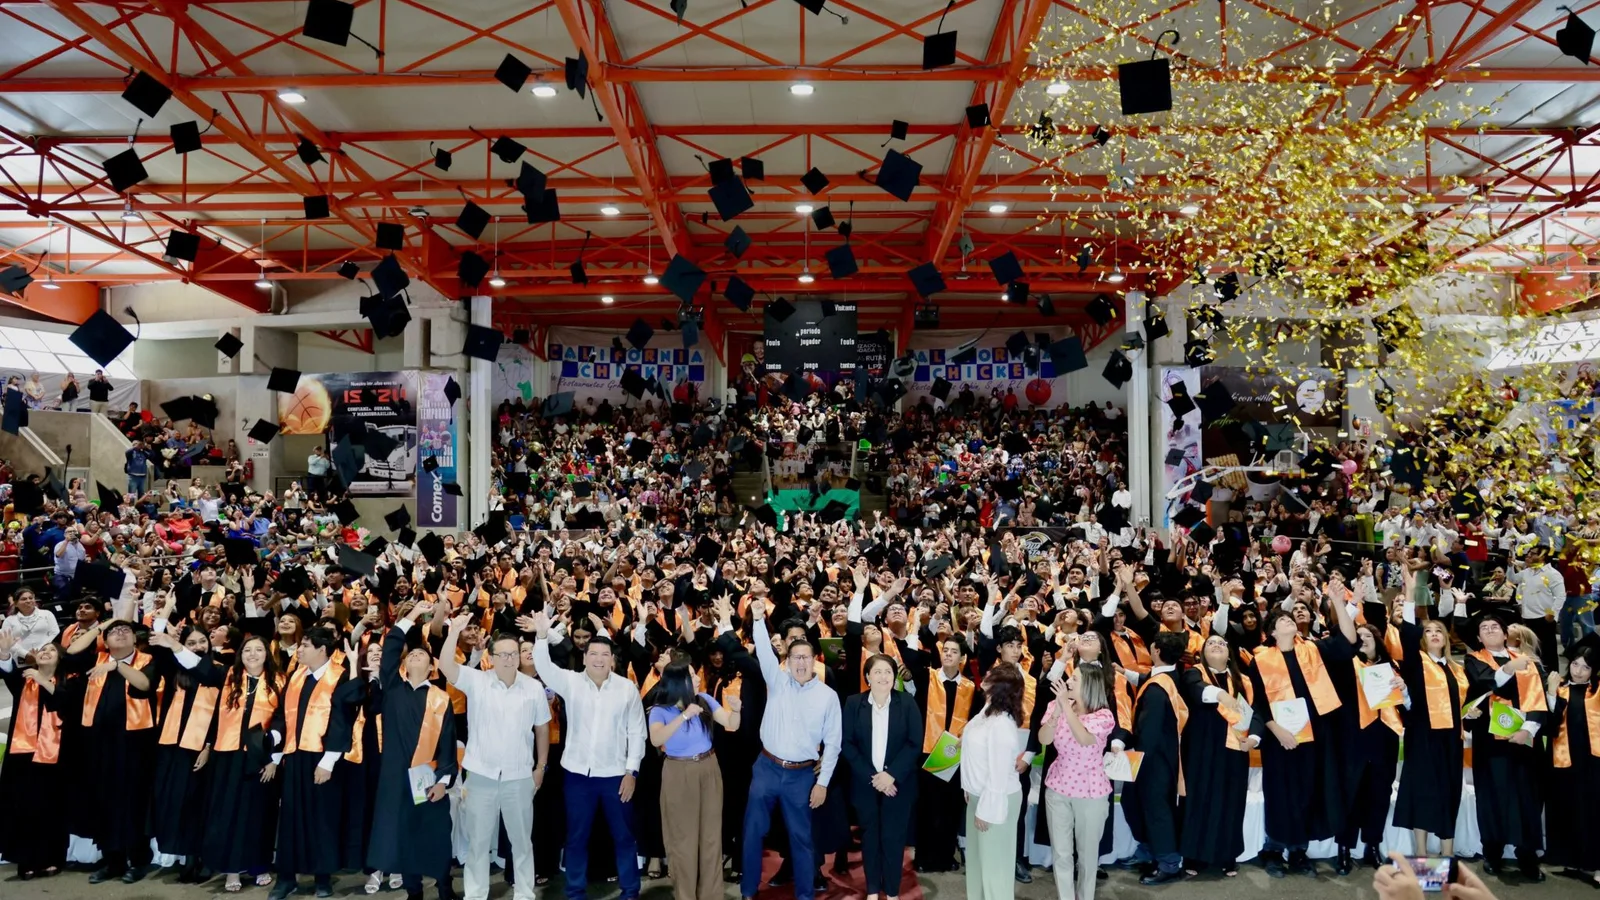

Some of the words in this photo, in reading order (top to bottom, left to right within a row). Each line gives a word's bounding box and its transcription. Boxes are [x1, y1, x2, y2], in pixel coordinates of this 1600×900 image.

[834, 304, 856, 312] Visitante
[800, 338, 822, 347] jugador
[840, 338, 855, 346] fouls
[865, 354, 887, 362] RUTAS
[803, 362, 819, 370] juego
[580, 363, 688, 380] CHIKEN
[343, 389, 407, 404] ISZU
[430, 471, 443, 523] Comex
